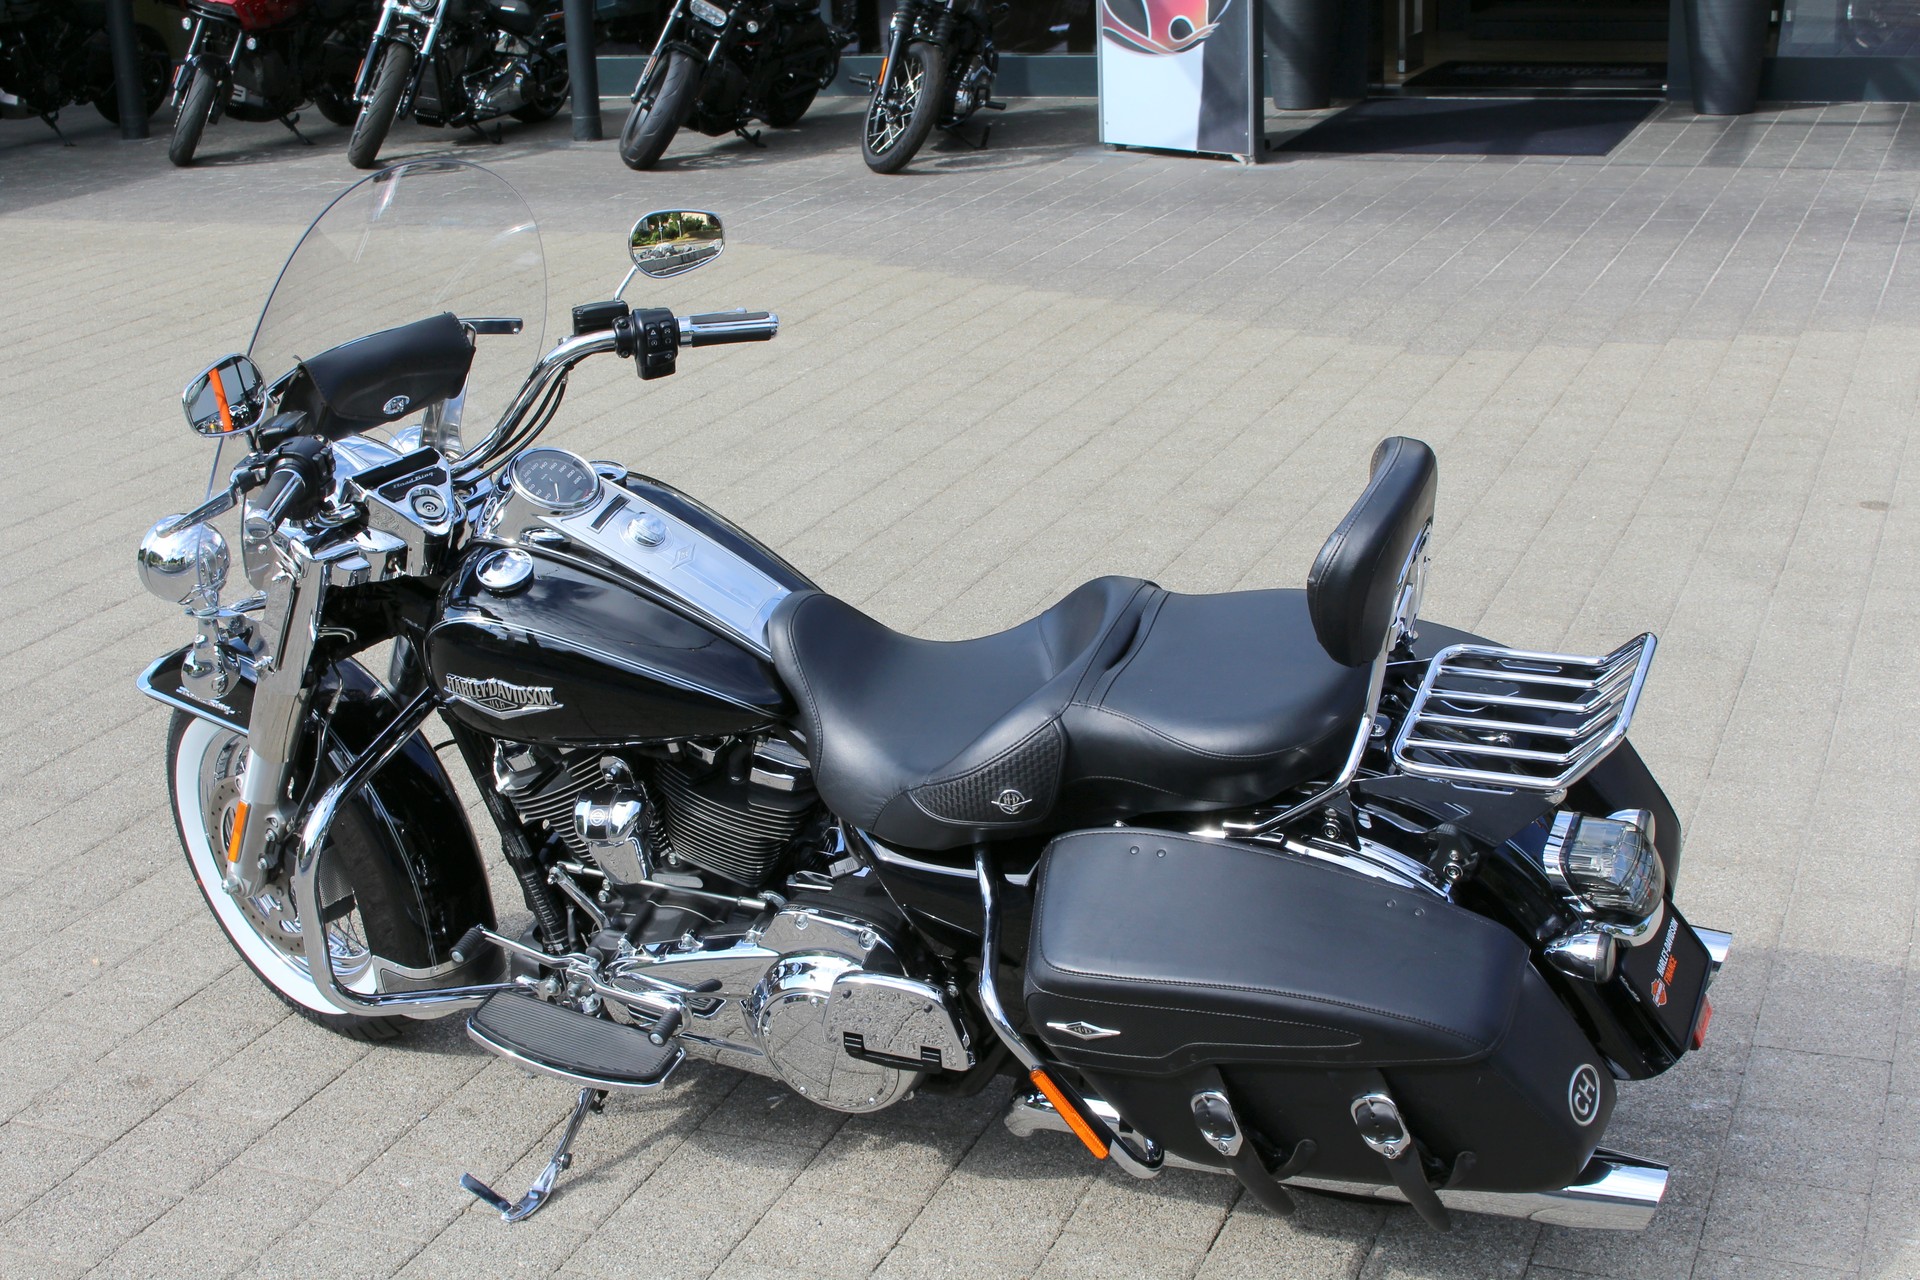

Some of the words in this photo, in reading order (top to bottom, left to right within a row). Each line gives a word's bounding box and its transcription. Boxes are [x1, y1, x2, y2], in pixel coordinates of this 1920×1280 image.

[1656, 917, 1679, 977] HARLEY-DAVIDSON
[1663, 954, 1678, 986] FINANCE
[1574, 1073, 1595, 1115] CH
